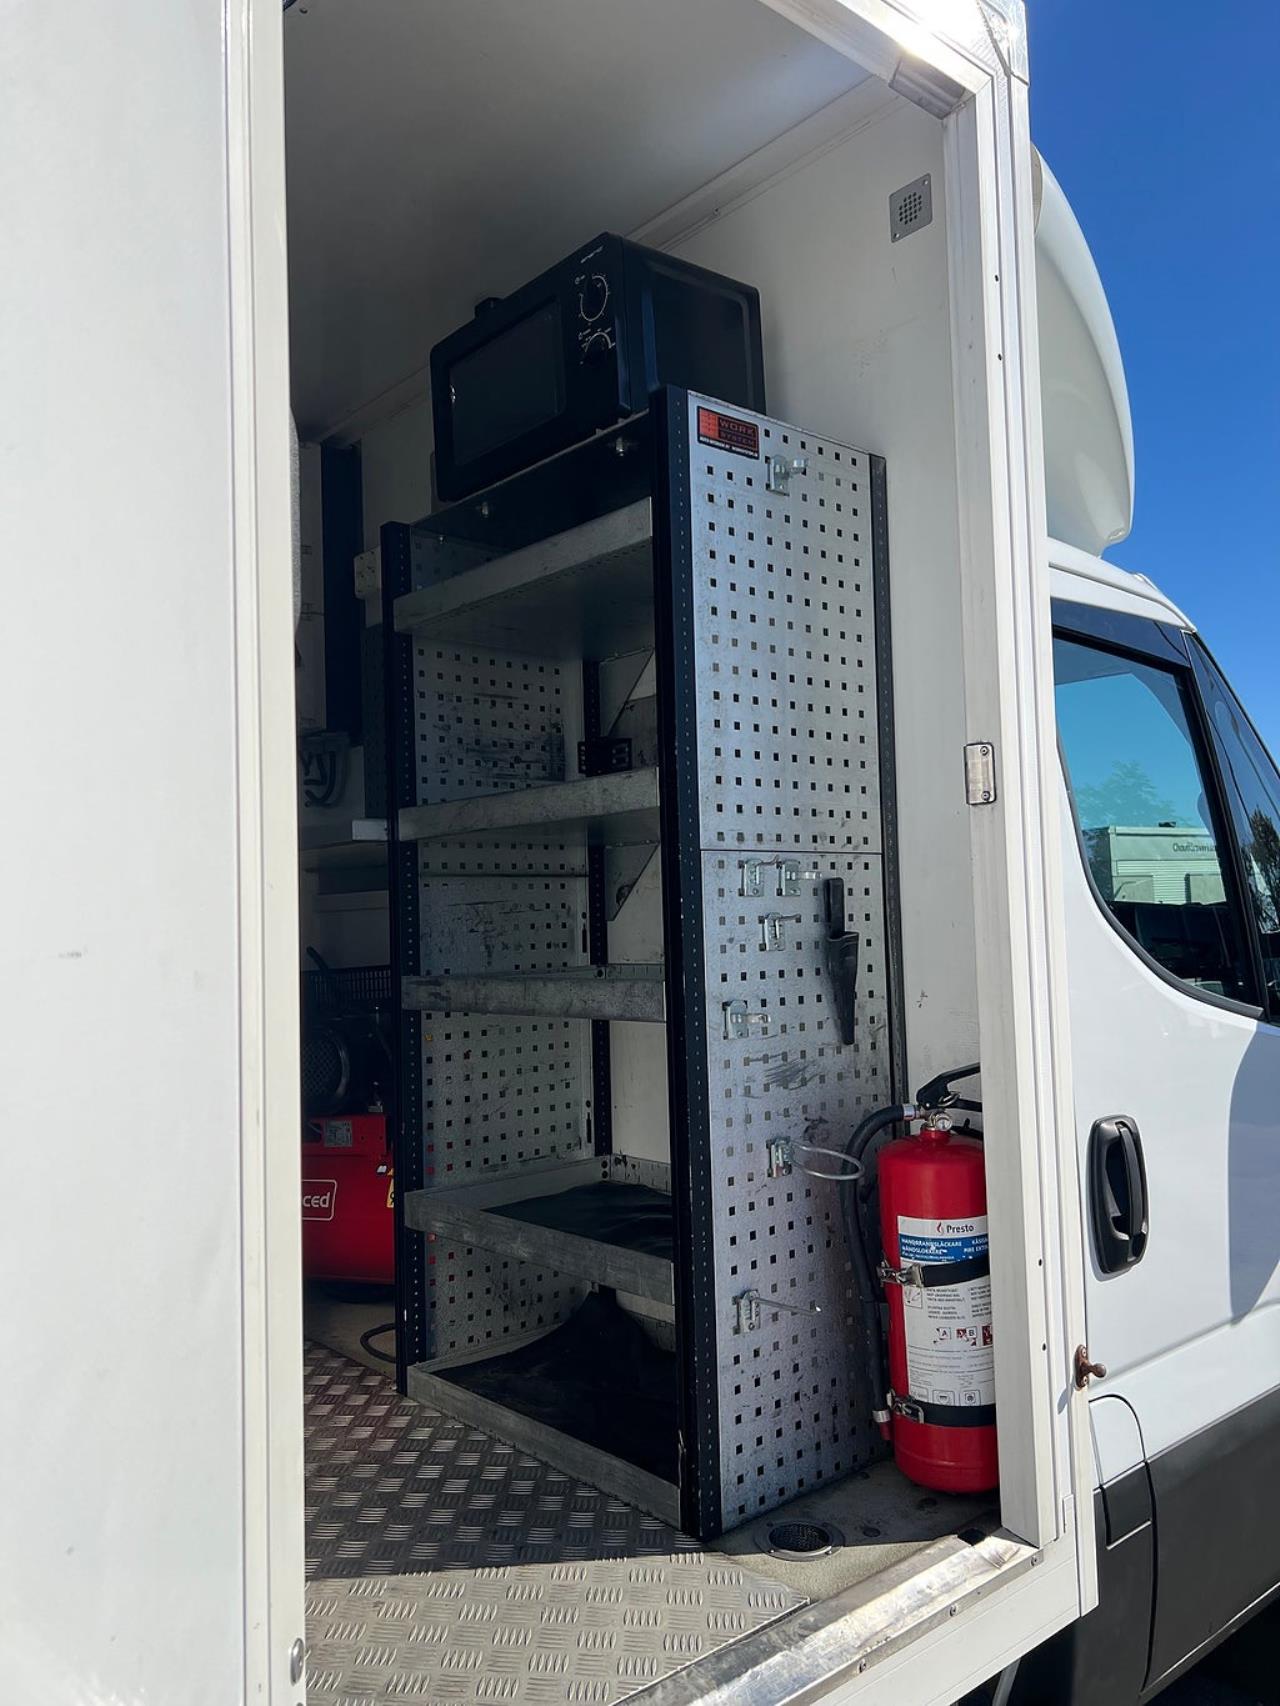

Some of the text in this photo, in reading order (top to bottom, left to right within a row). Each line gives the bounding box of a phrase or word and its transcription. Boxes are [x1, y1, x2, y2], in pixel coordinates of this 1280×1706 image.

[719, 418, 754, 434] WORK
[720, 431, 754, 445] SYSTEM
[946, 1223, 975, 1234] Presto
